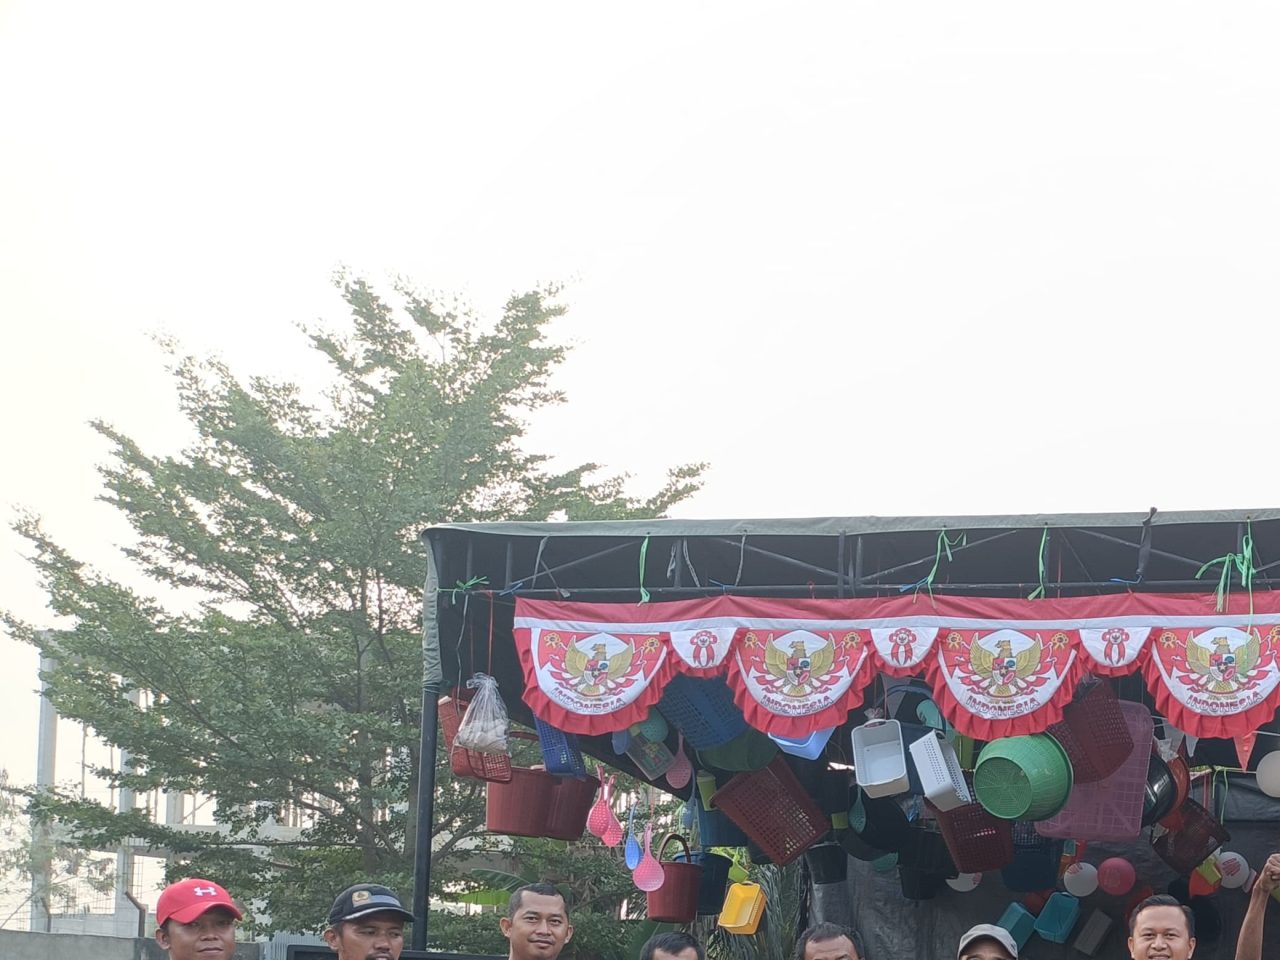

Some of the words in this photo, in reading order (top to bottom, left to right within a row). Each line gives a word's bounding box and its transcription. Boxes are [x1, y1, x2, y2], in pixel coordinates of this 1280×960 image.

[551, 687, 627, 711] INDONESIA
[761, 693, 835, 716] INDONESIA
[966, 694, 1041, 717] INDONESIA
[1186, 690, 1264, 714] INDONESIA
